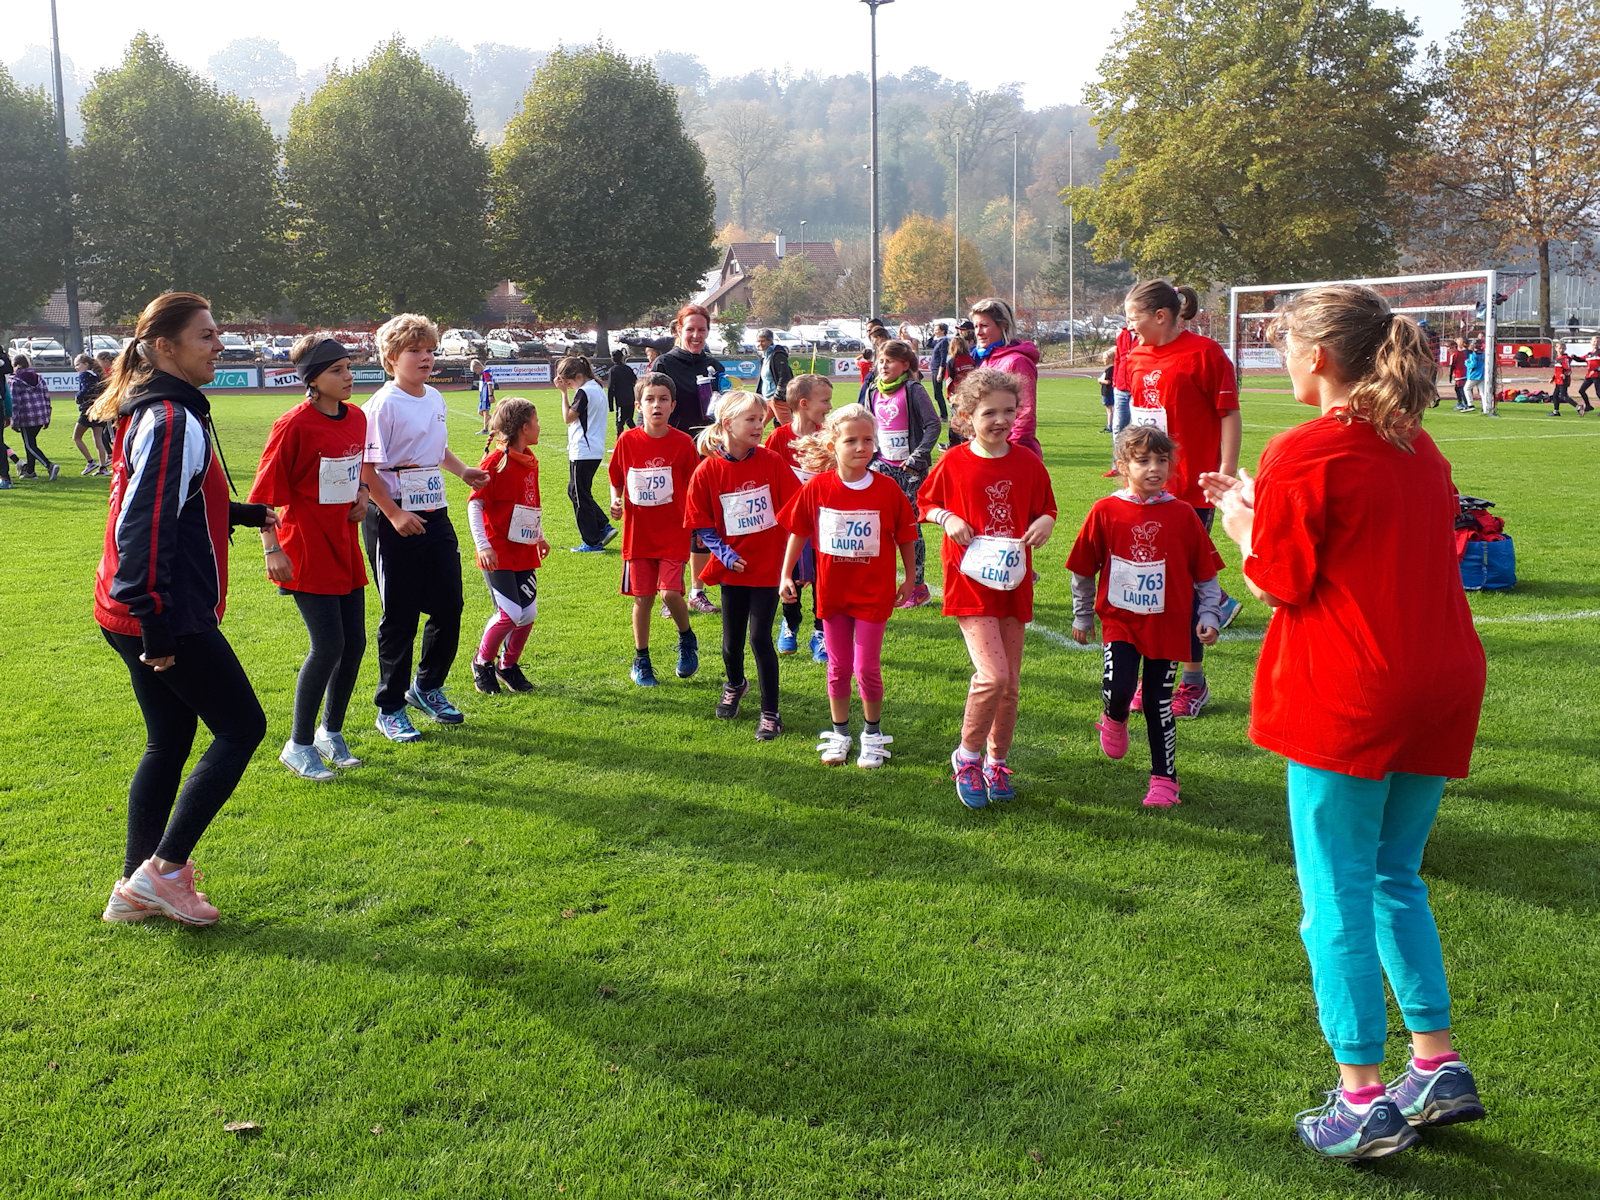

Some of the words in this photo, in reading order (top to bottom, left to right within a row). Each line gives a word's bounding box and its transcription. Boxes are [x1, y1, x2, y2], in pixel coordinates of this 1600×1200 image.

[890, 437, 909, 447] 122
[646, 475, 665, 490] 759
[746, 496, 767, 515] 758
[737, 514, 765, 529] JENNY
[846, 521, 872, 537] 766
[831, 538, 865, 551] LAURA
[981, 566, 1010, 583] LENA
[1136, 572, 1163, 592] 763
[1123, 589, 1159, 606] LAURA
